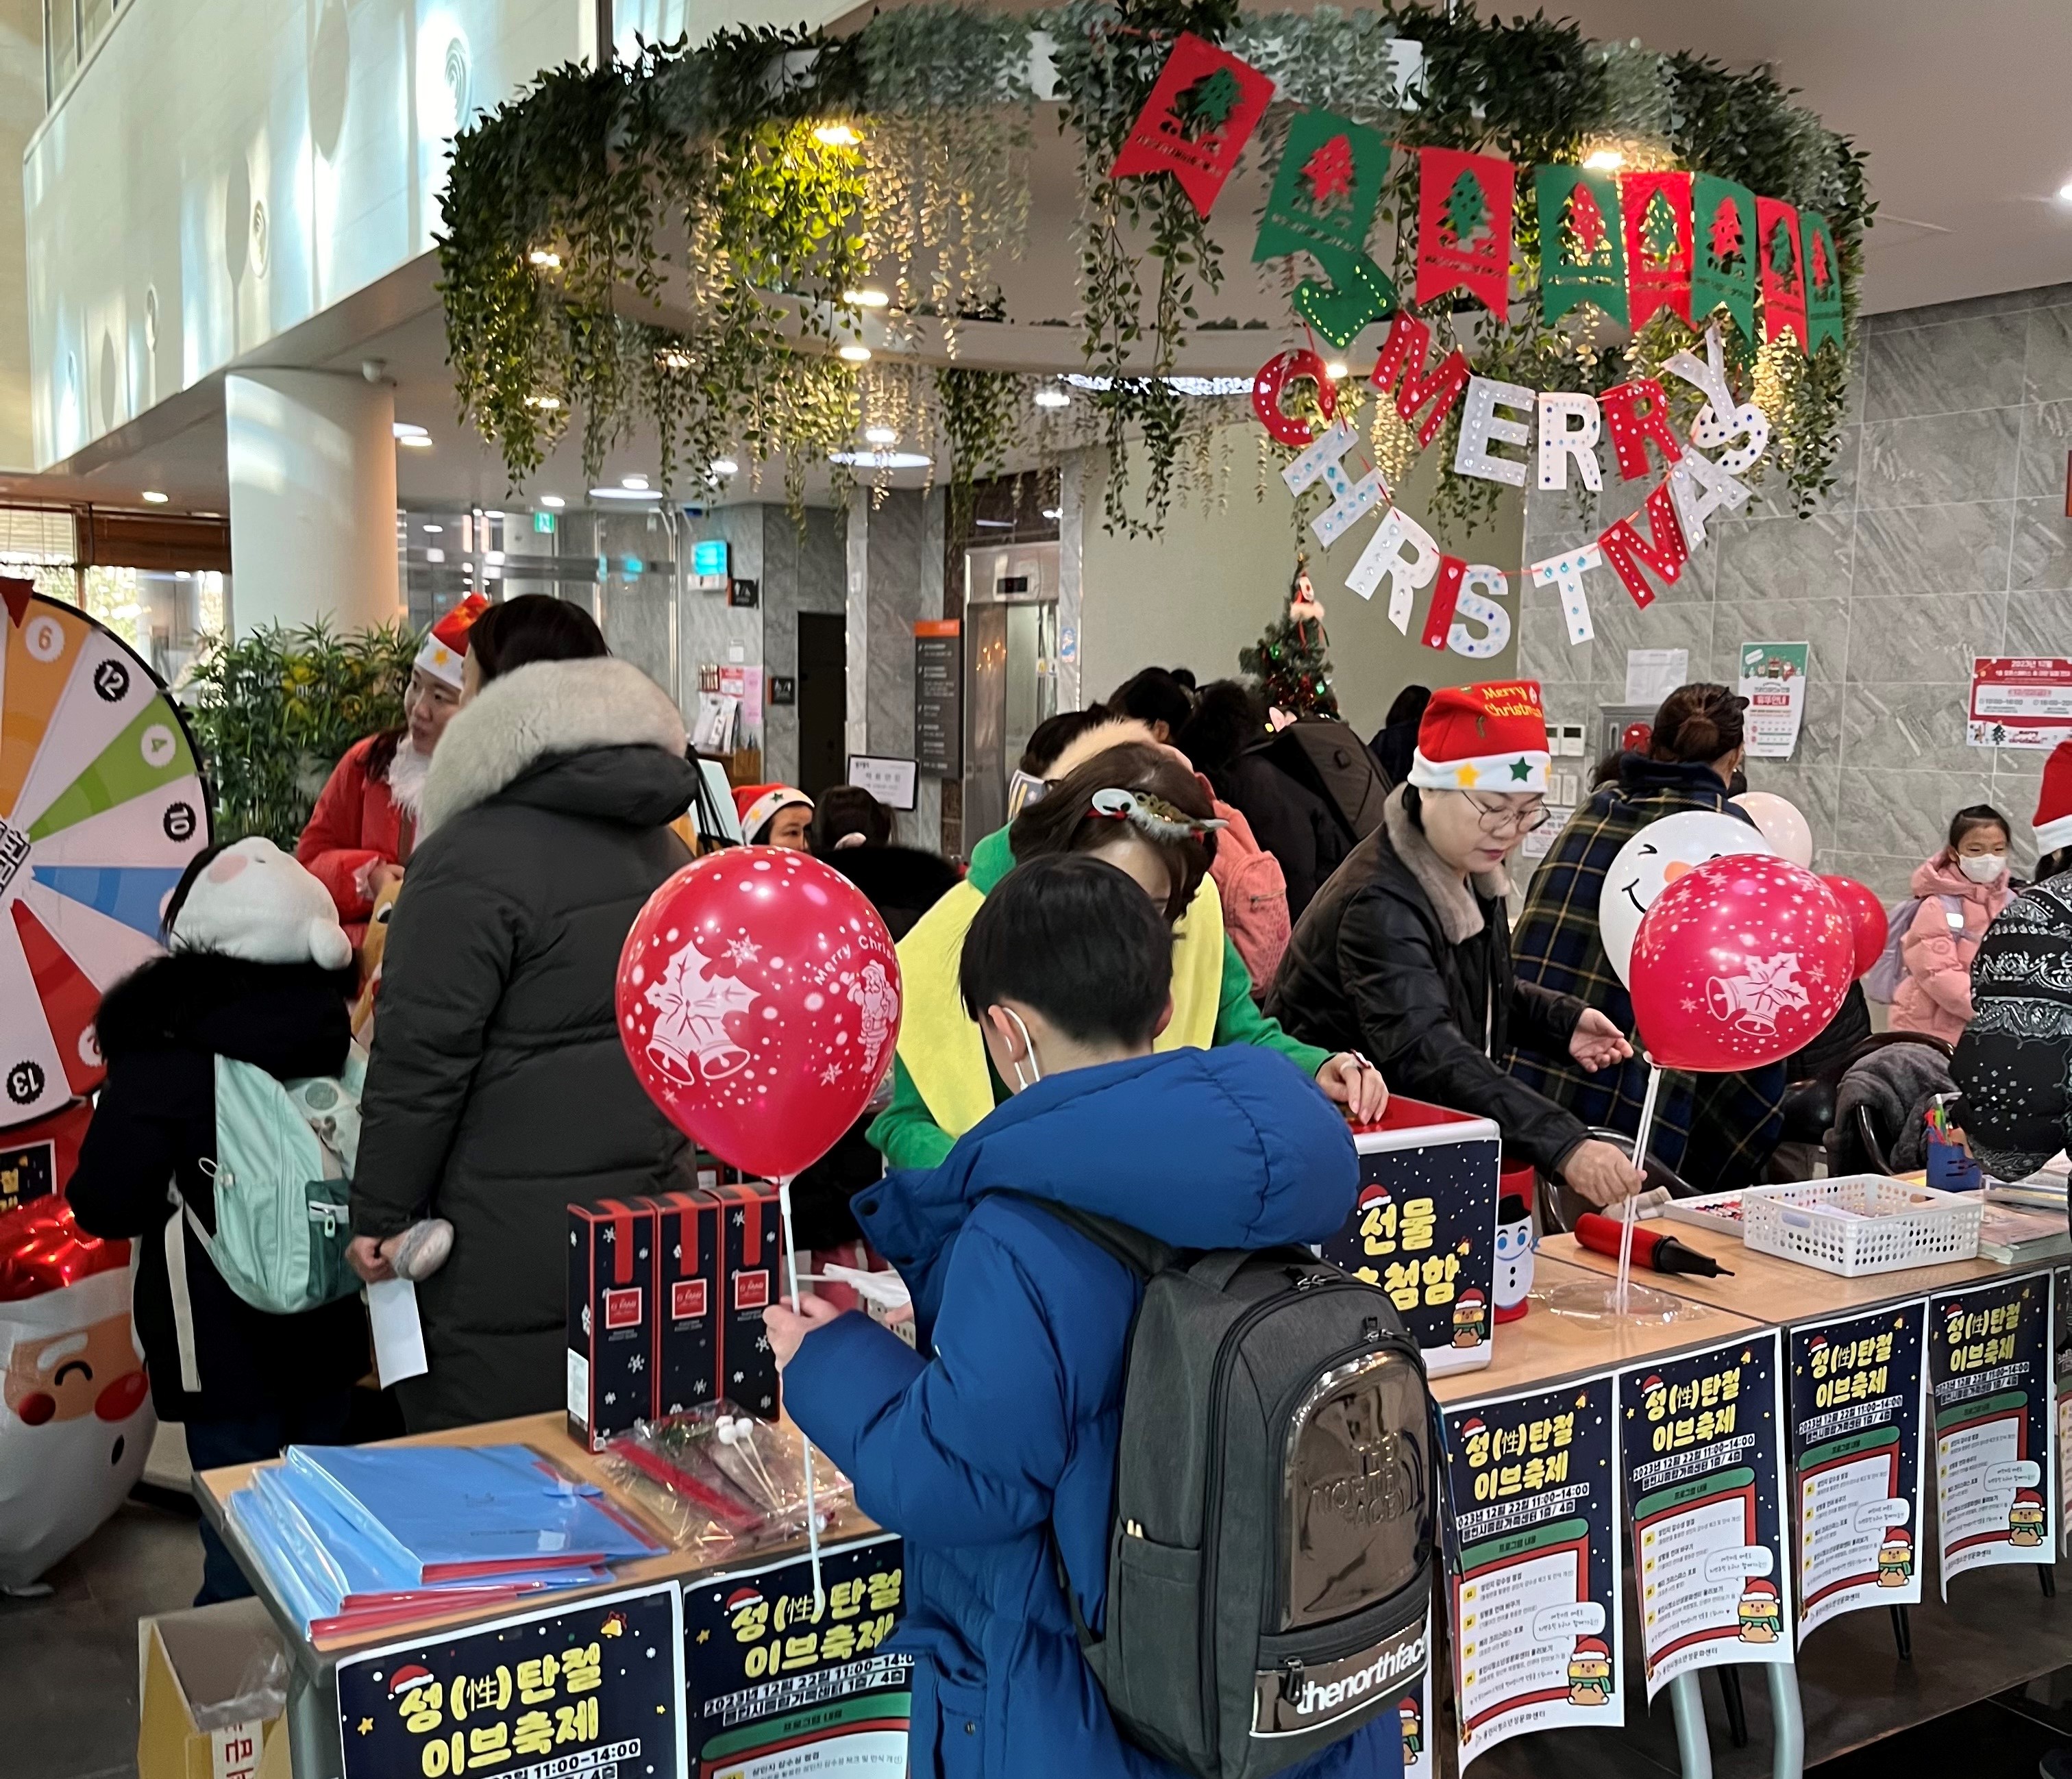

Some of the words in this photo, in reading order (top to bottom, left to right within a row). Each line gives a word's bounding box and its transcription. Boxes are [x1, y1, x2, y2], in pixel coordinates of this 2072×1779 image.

[99, 664, 125, 698] 12
[1481, 686, 1528, 701] Merry
[150, 737, 169, 753] 4
[169, 806, 190, 835] 10
[814, 943, 851, 986] Merry
[12, 1067, 40, 1097] 13
[1359, 1197, 1437, 1256] 선물
[1950, 1333, 2015, 1372] 이브축제
[1816, 1365, 1888, 1408] 이브축제
[1652, 1403, 1736, 1452] 이브축제
[1474, 1450, 1569, 1502] 이브축제
[1634, 1462, 1661, 1480] 2023년
[1664, 1456, 1681, 1469] 12월
[1683, 1450, 1701, 1463] 22일
[1457, 1511, 1483, 1528] 023년
[1486, 1506, 1506, 1519] 12월
[1508, 1500, 1529, 1514] 22일
[745, 1613, 894, 1678] 이브축제
[1296, 1638, 1426, 1715] thenorthfac
[422, 1695, 600, 1778] 이브축제
